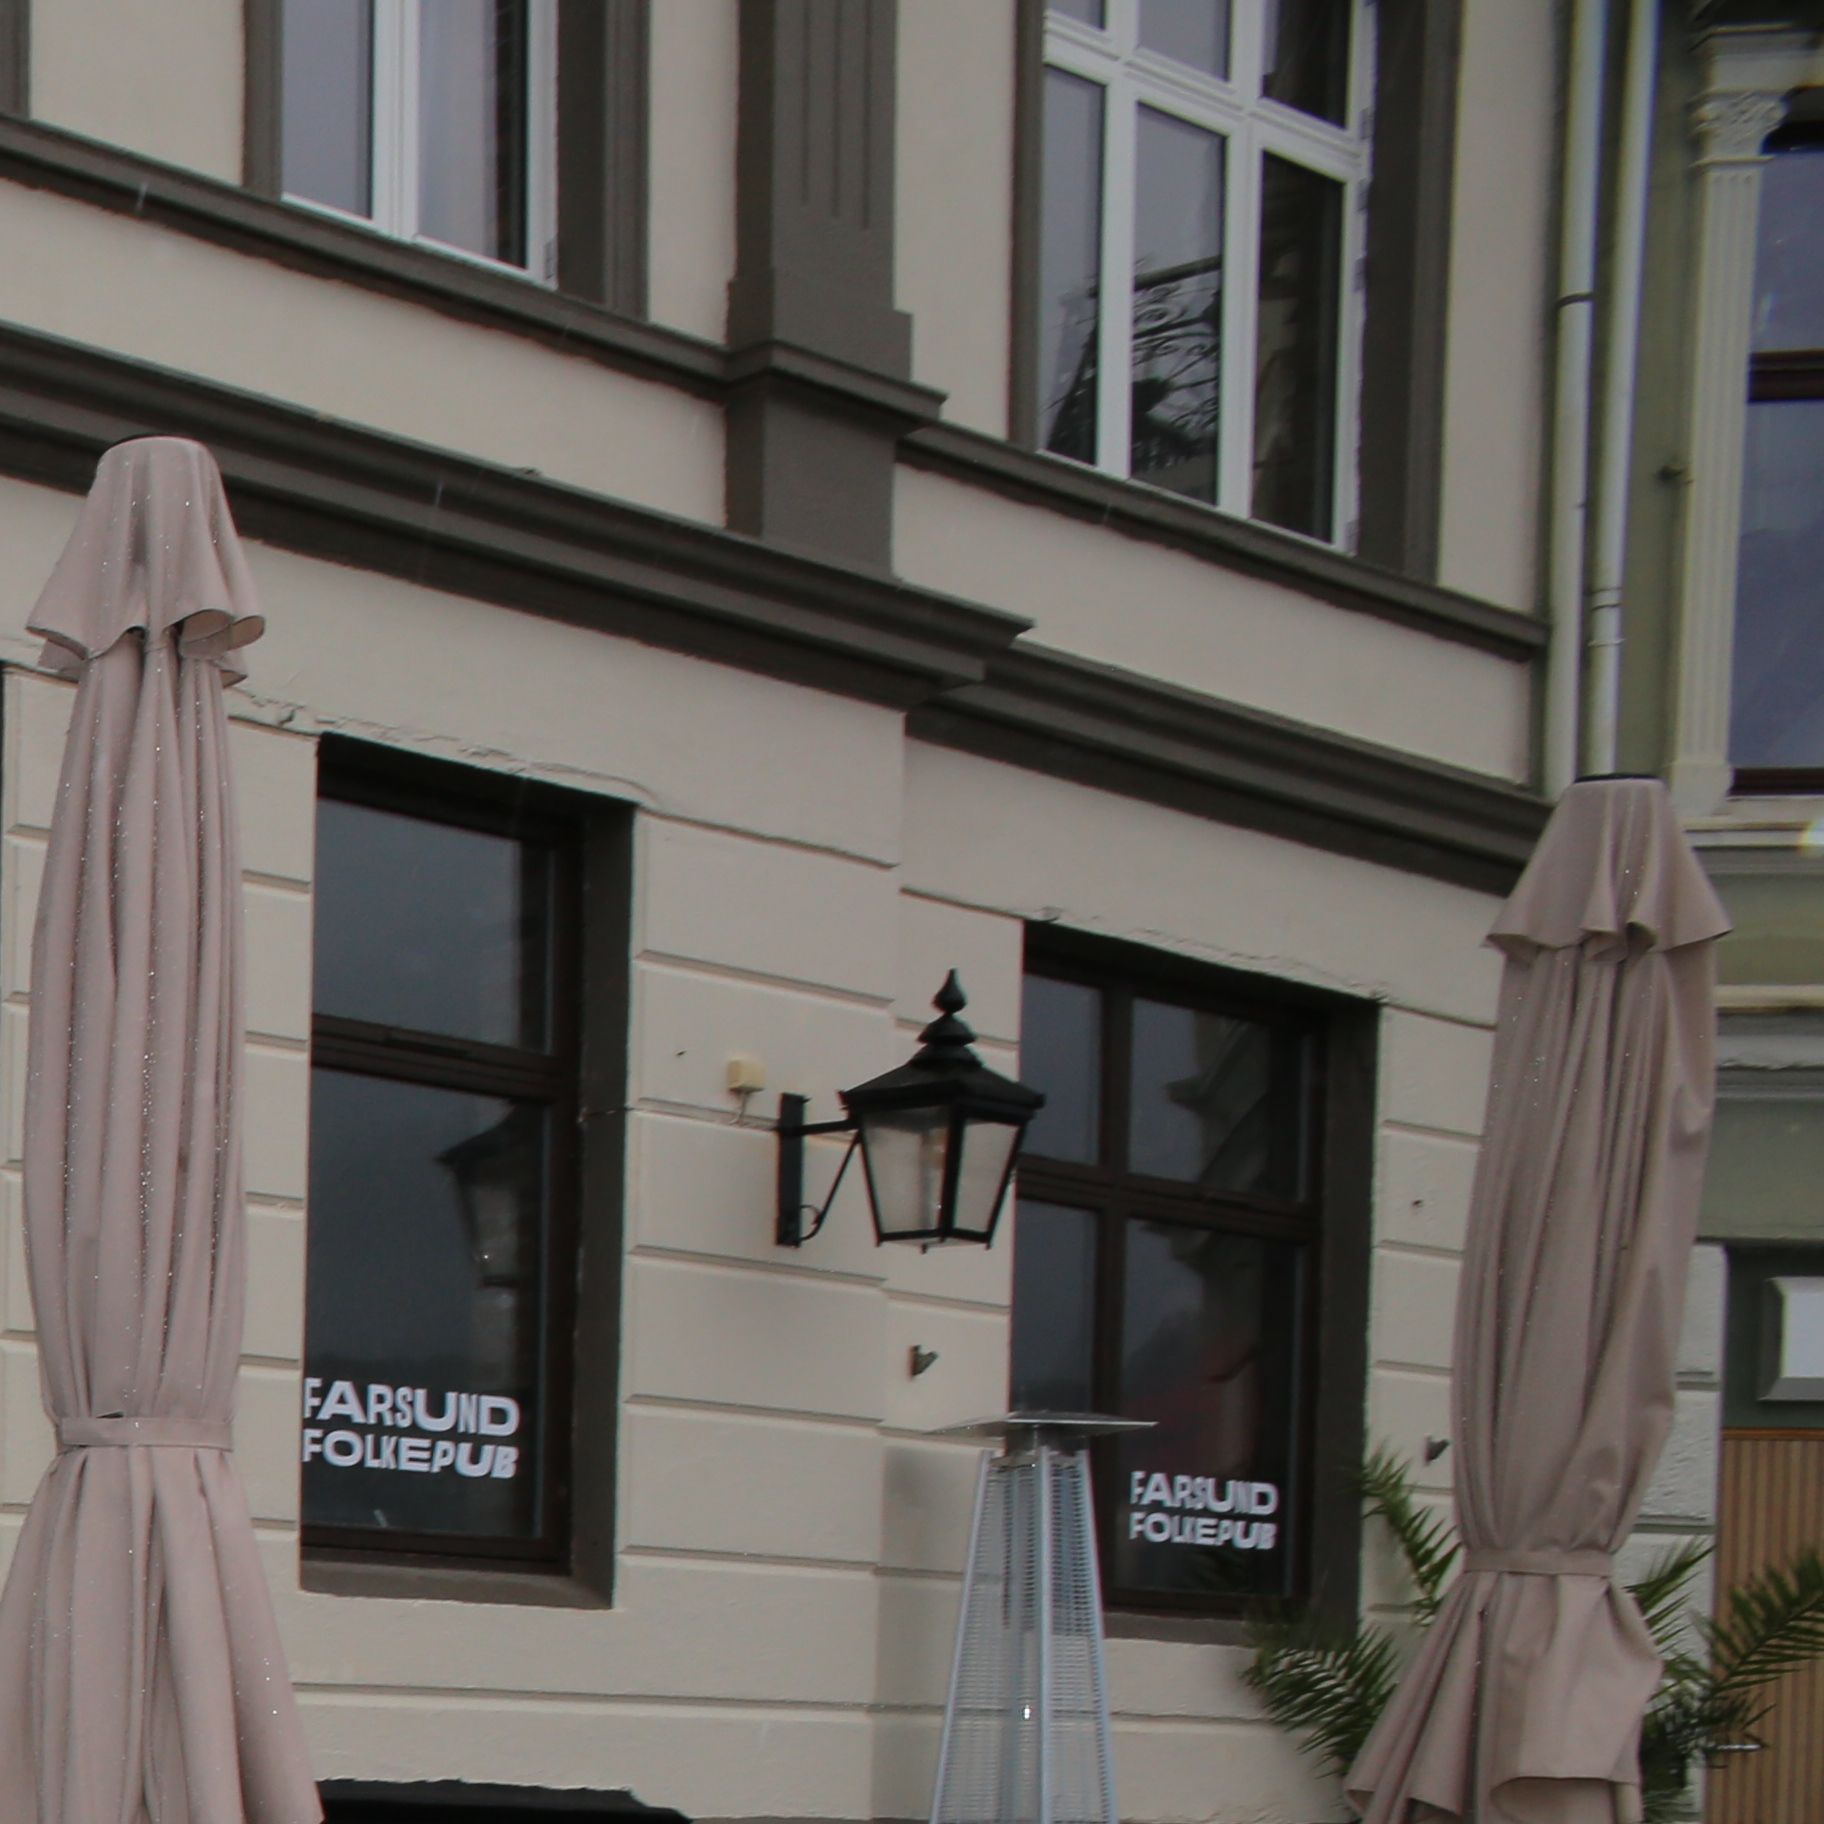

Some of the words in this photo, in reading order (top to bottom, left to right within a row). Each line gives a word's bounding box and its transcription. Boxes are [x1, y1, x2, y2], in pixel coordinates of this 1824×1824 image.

[303, 1377, 520, 1437] FARSUND
[302, 1427, 520, 1479] FOLKEPUB
[1130, 1470, 1279, 1515] FARSUND
